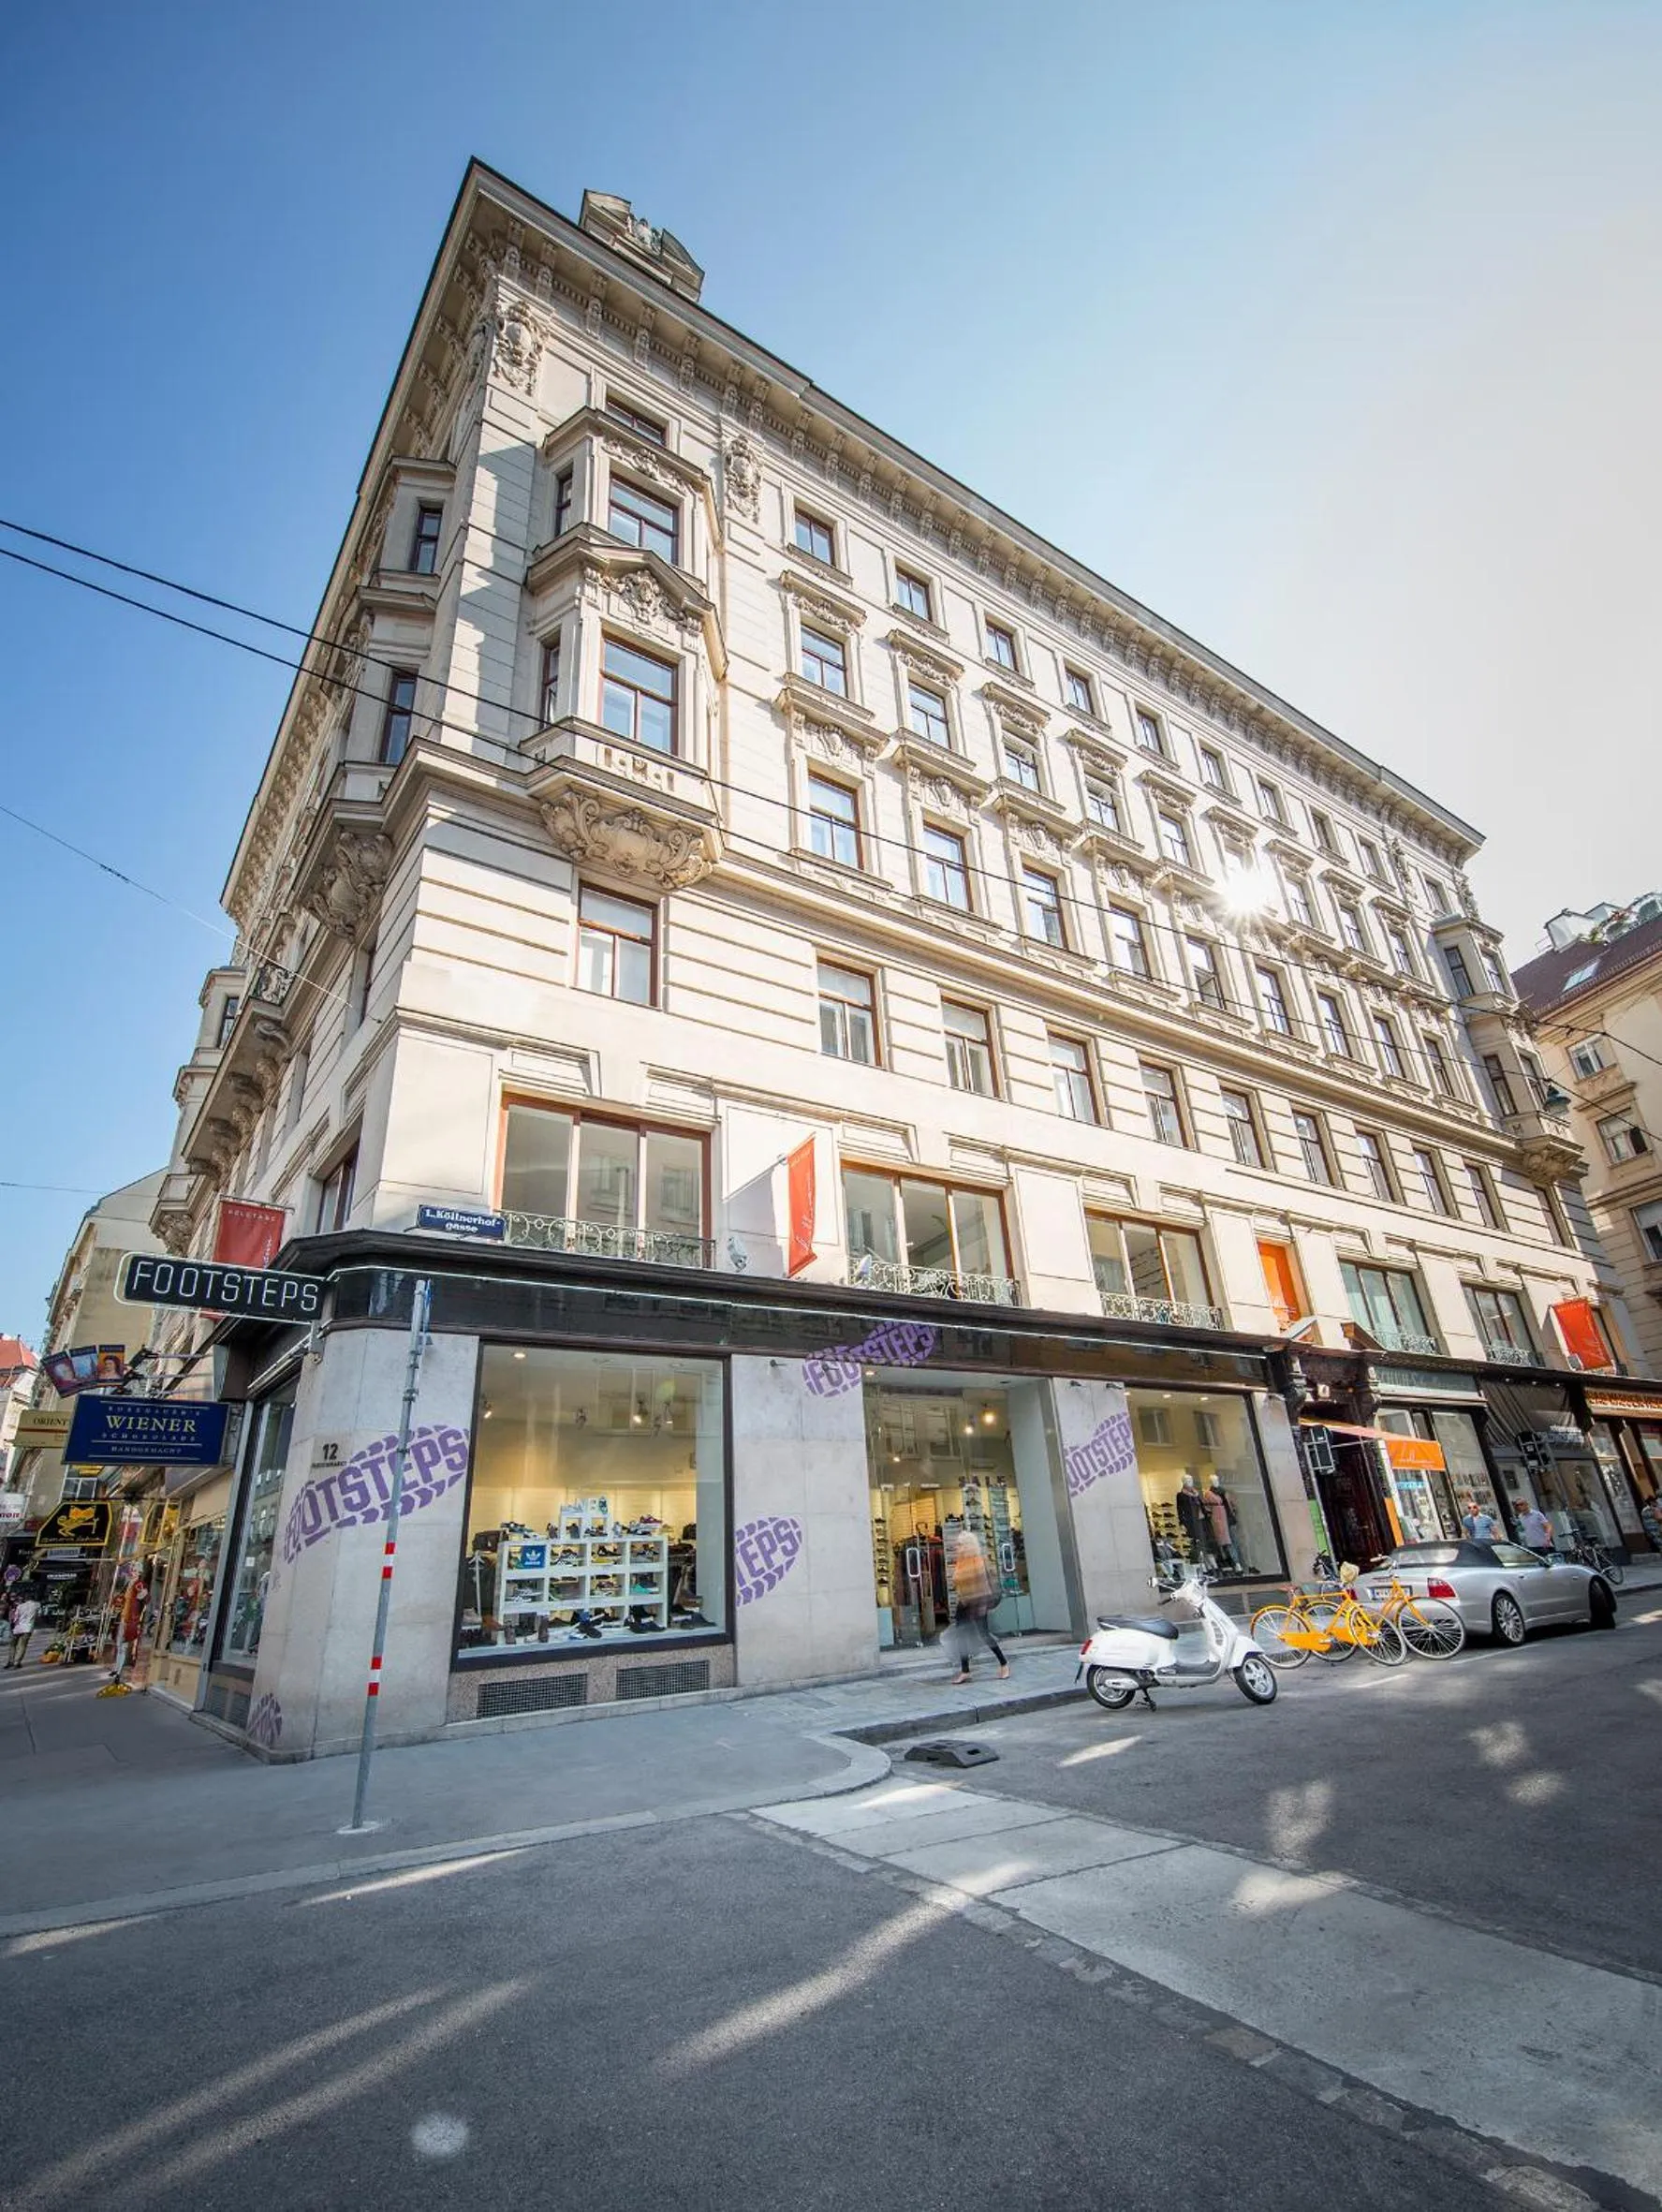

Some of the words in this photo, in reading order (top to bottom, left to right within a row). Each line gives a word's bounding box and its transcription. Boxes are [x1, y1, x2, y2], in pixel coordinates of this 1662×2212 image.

[445, 1222, 478, 1233] gasse
[132, 1261, 319, 1312] FOOTSTEPS
[106, 1415, 197, 1433] WIENER
[323, 1443, 338, 1460] 12
